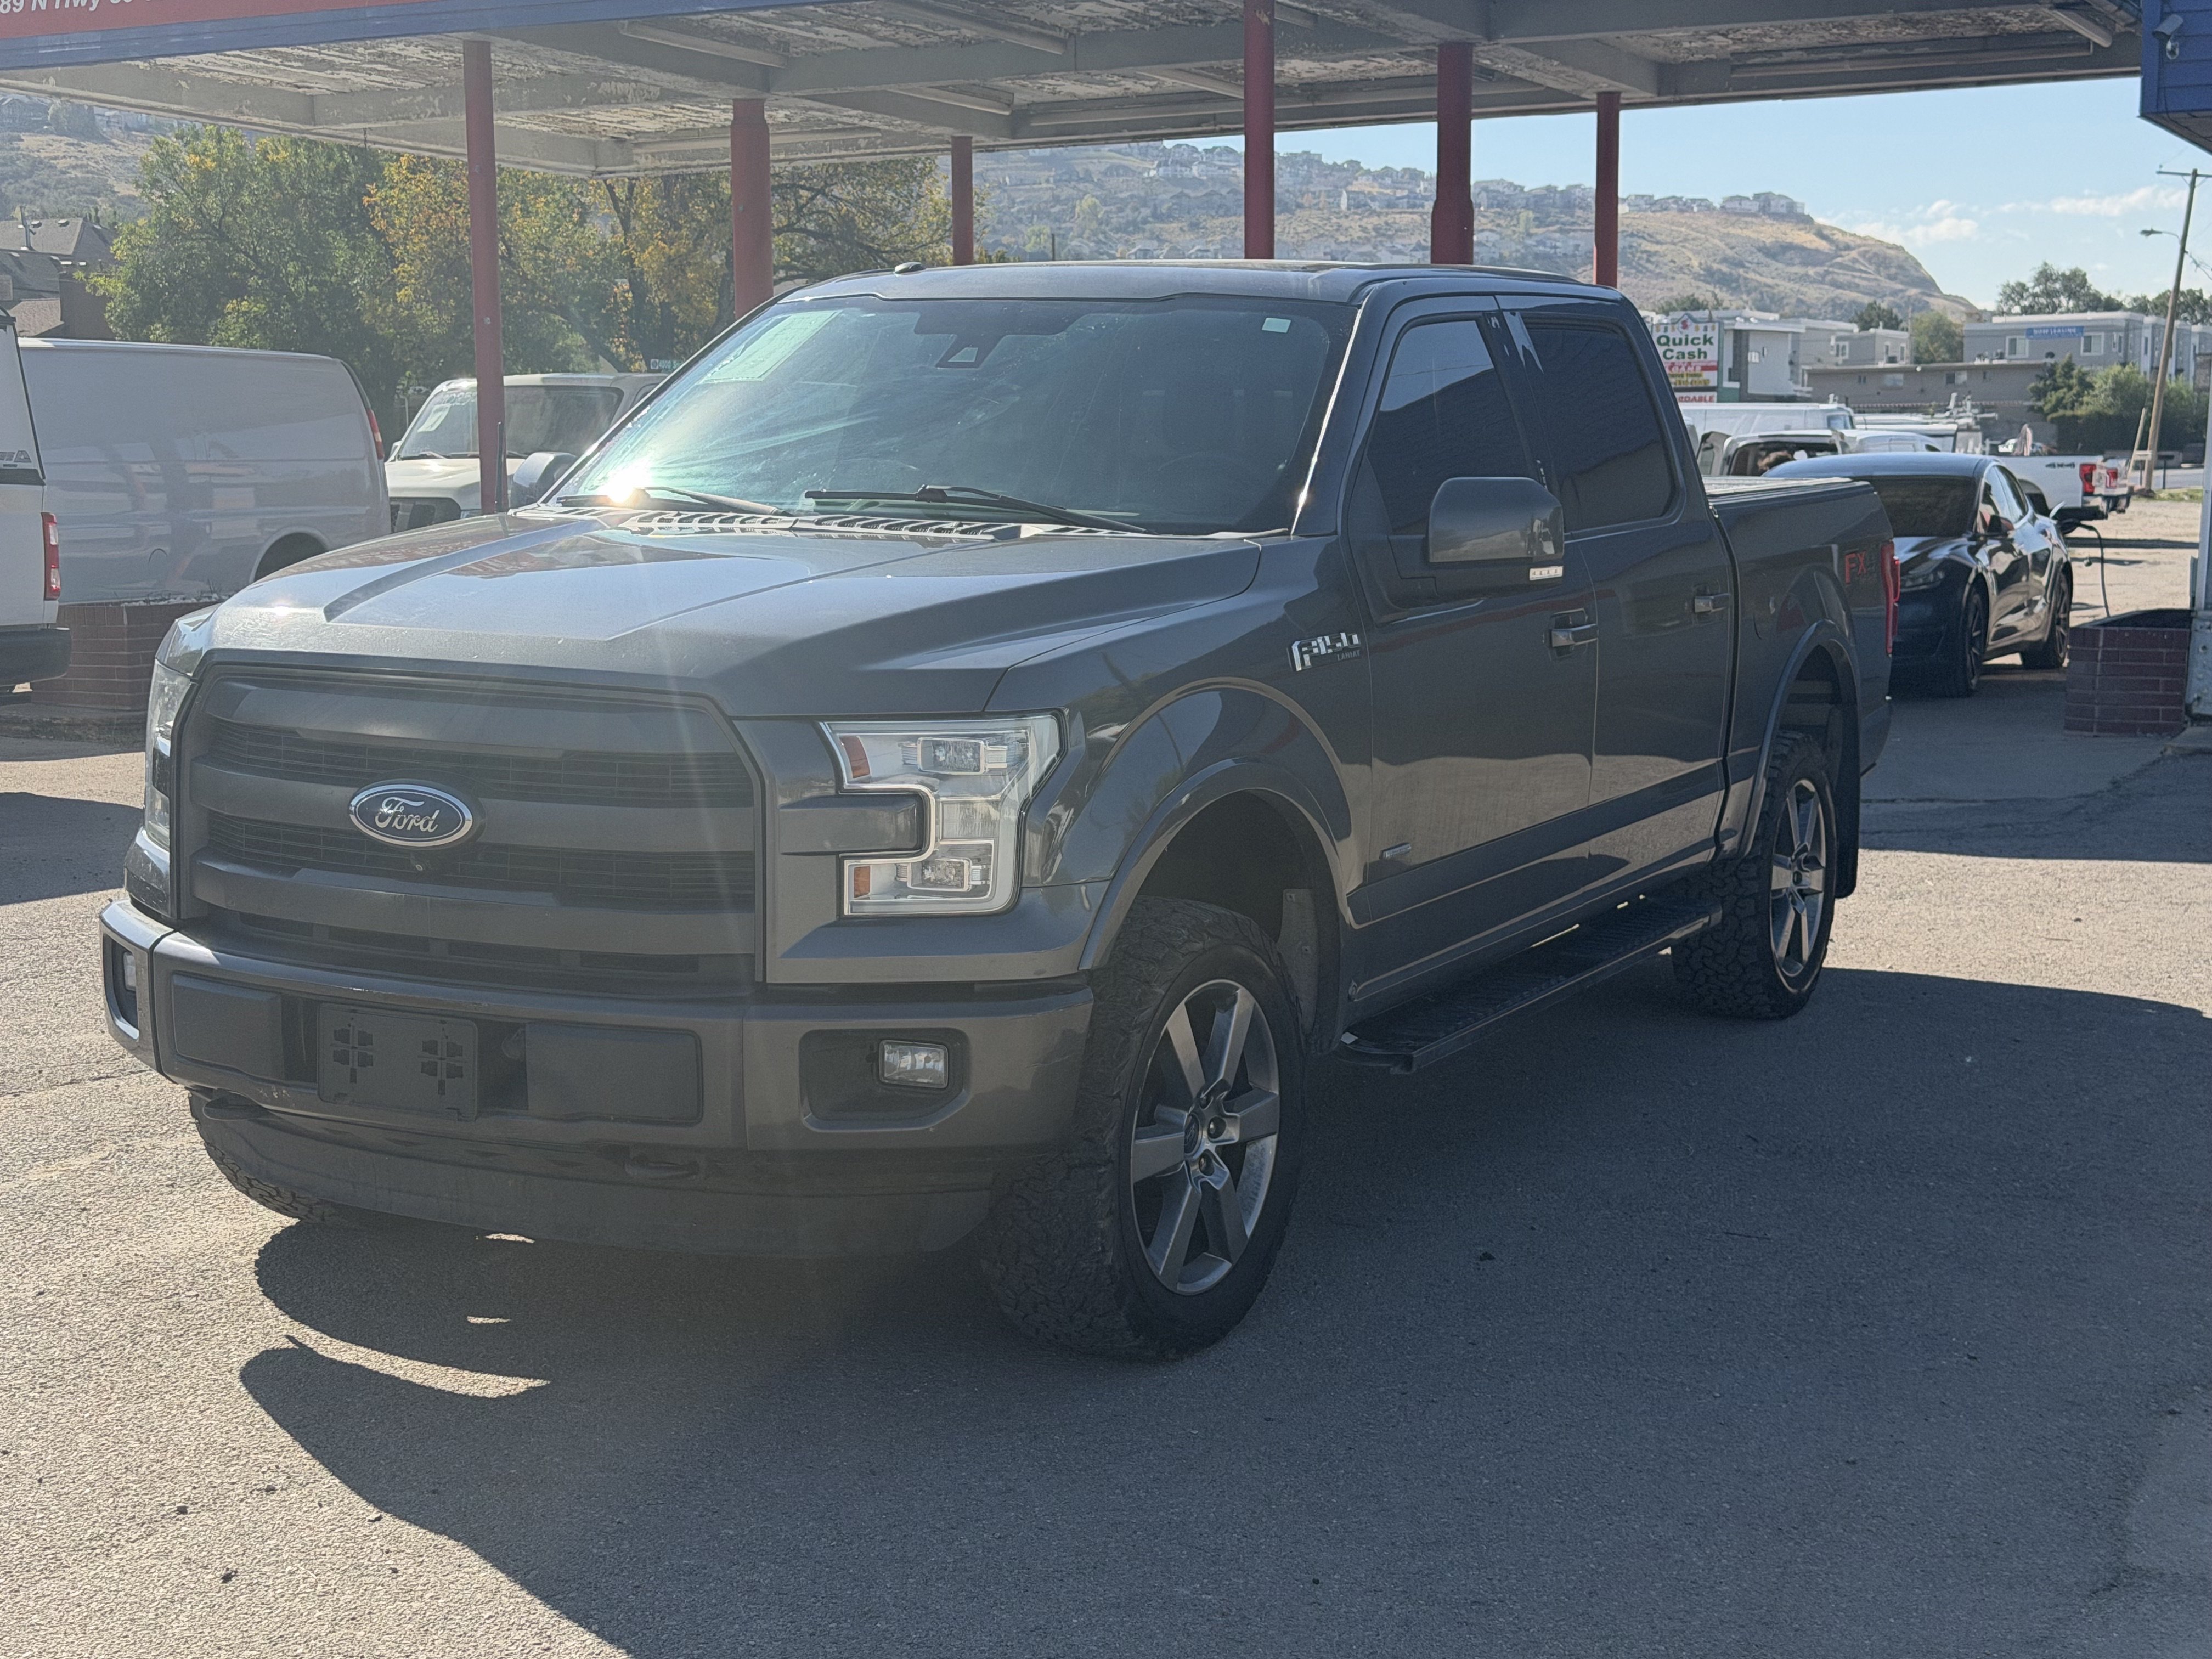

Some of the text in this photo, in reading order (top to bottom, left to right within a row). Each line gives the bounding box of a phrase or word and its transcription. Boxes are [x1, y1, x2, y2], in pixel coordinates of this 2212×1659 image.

[32, 0, 47, 11] N
[1656, 334, 1714, 347] Quick
[1662, 348, 1707, 360] Cash
[1337, 650, 1361, 661] LARIAT
[375, 797, 440, 832] Ford
